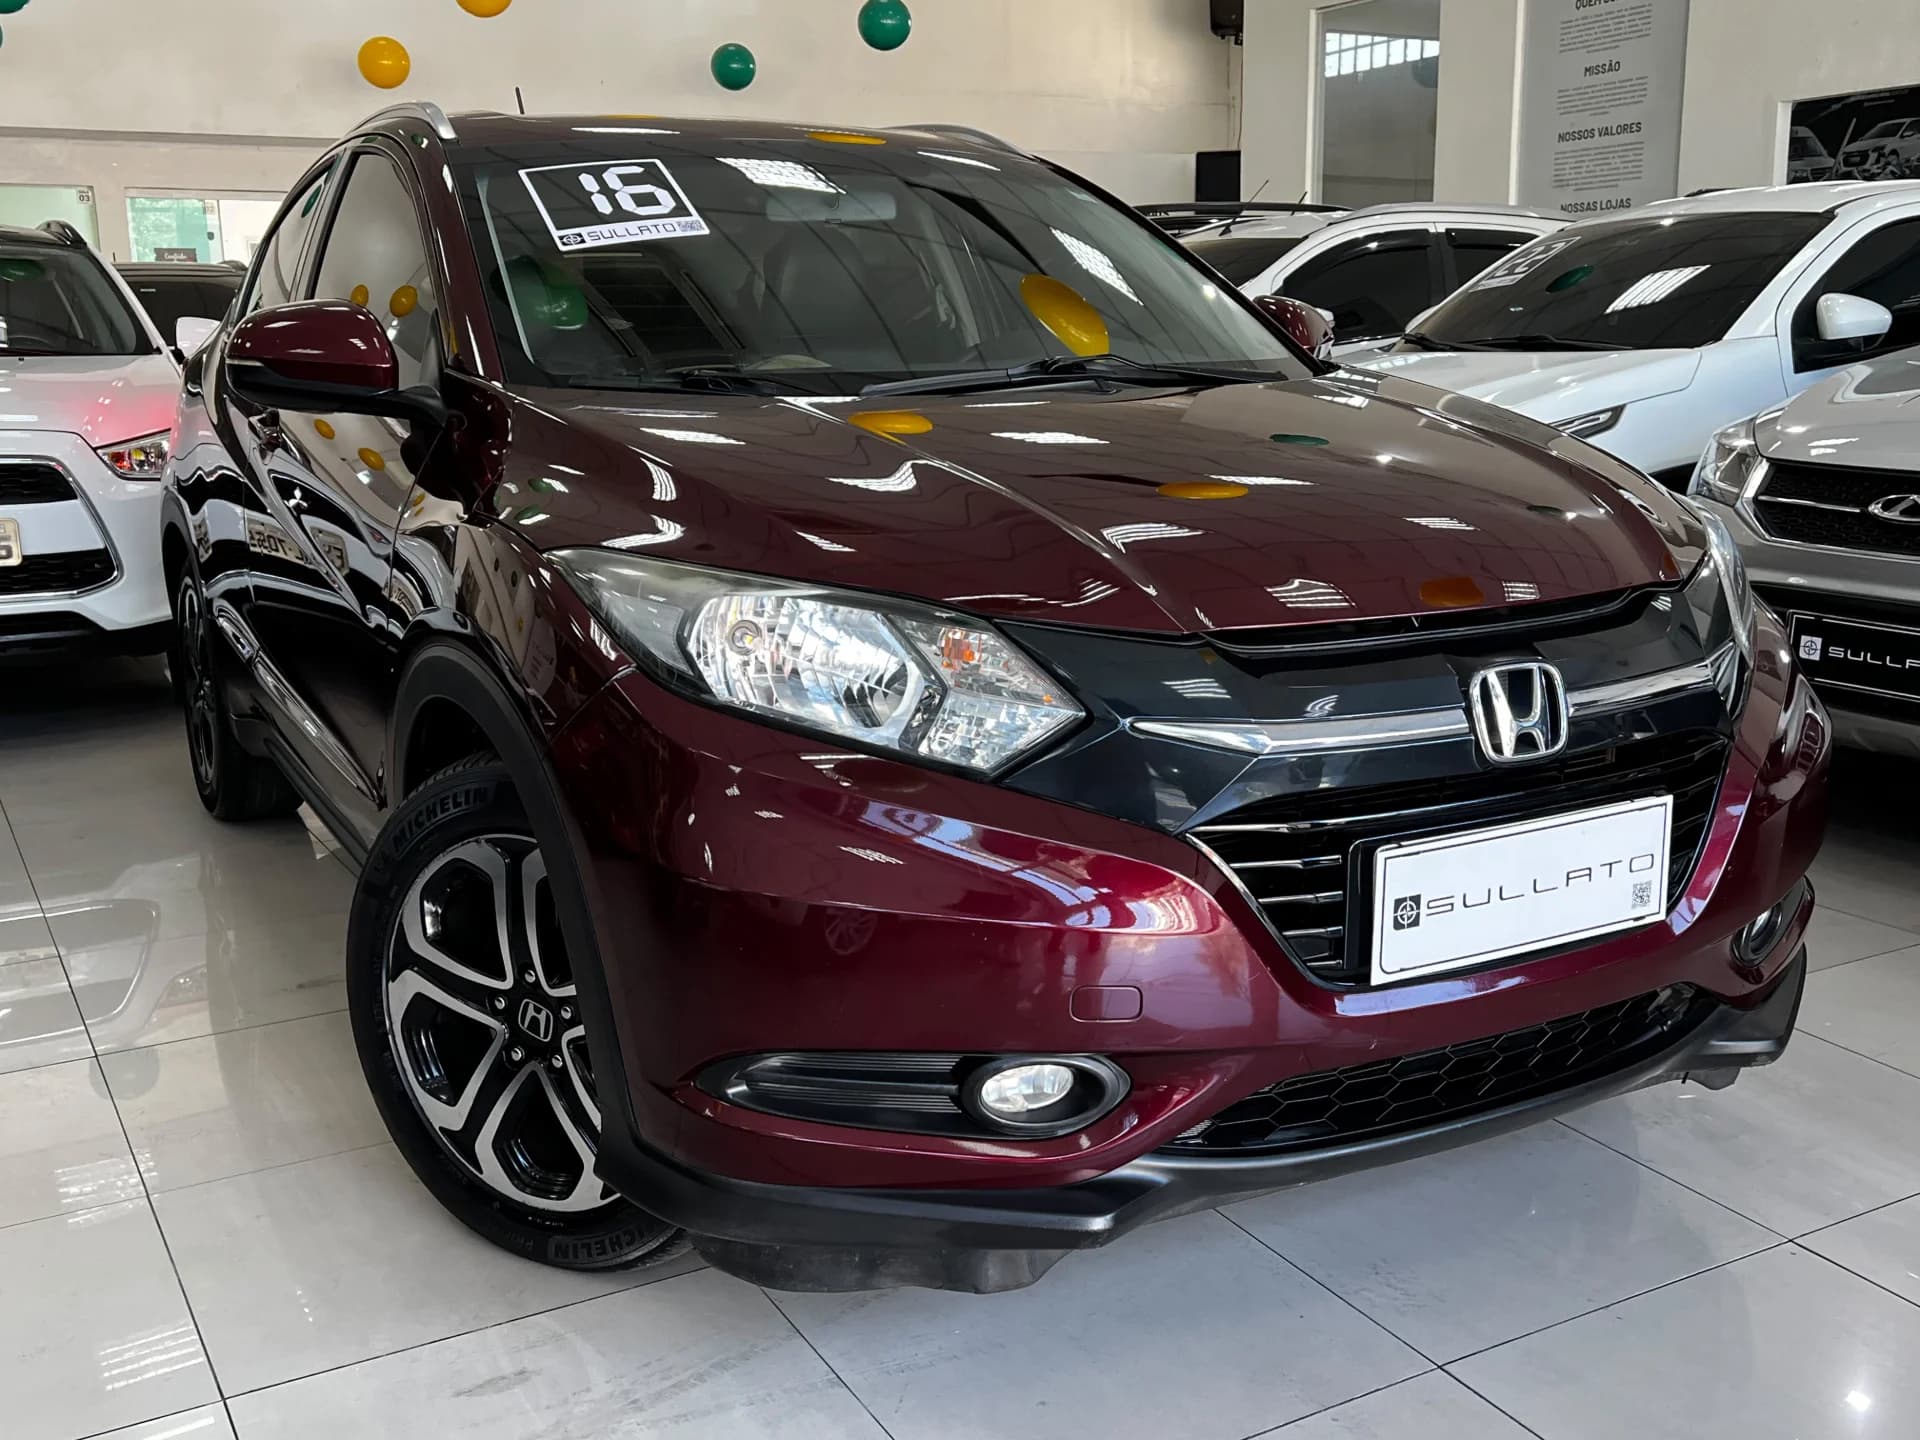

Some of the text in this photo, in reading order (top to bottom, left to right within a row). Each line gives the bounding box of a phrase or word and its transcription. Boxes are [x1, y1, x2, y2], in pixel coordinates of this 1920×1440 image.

[1584, 60, 1621, 77] MISSÃO
[1557, 122, 1642, 143] NOSSOS VALORES
[578, 165, 676, 215] 16
[1599, 197, 1631, 211] LOJAS
[586, 222, 677, 242] SULLATO
[392, 787, 489, 852] MICHELIN
[1426, 853, 1654, 917] SULLATO
